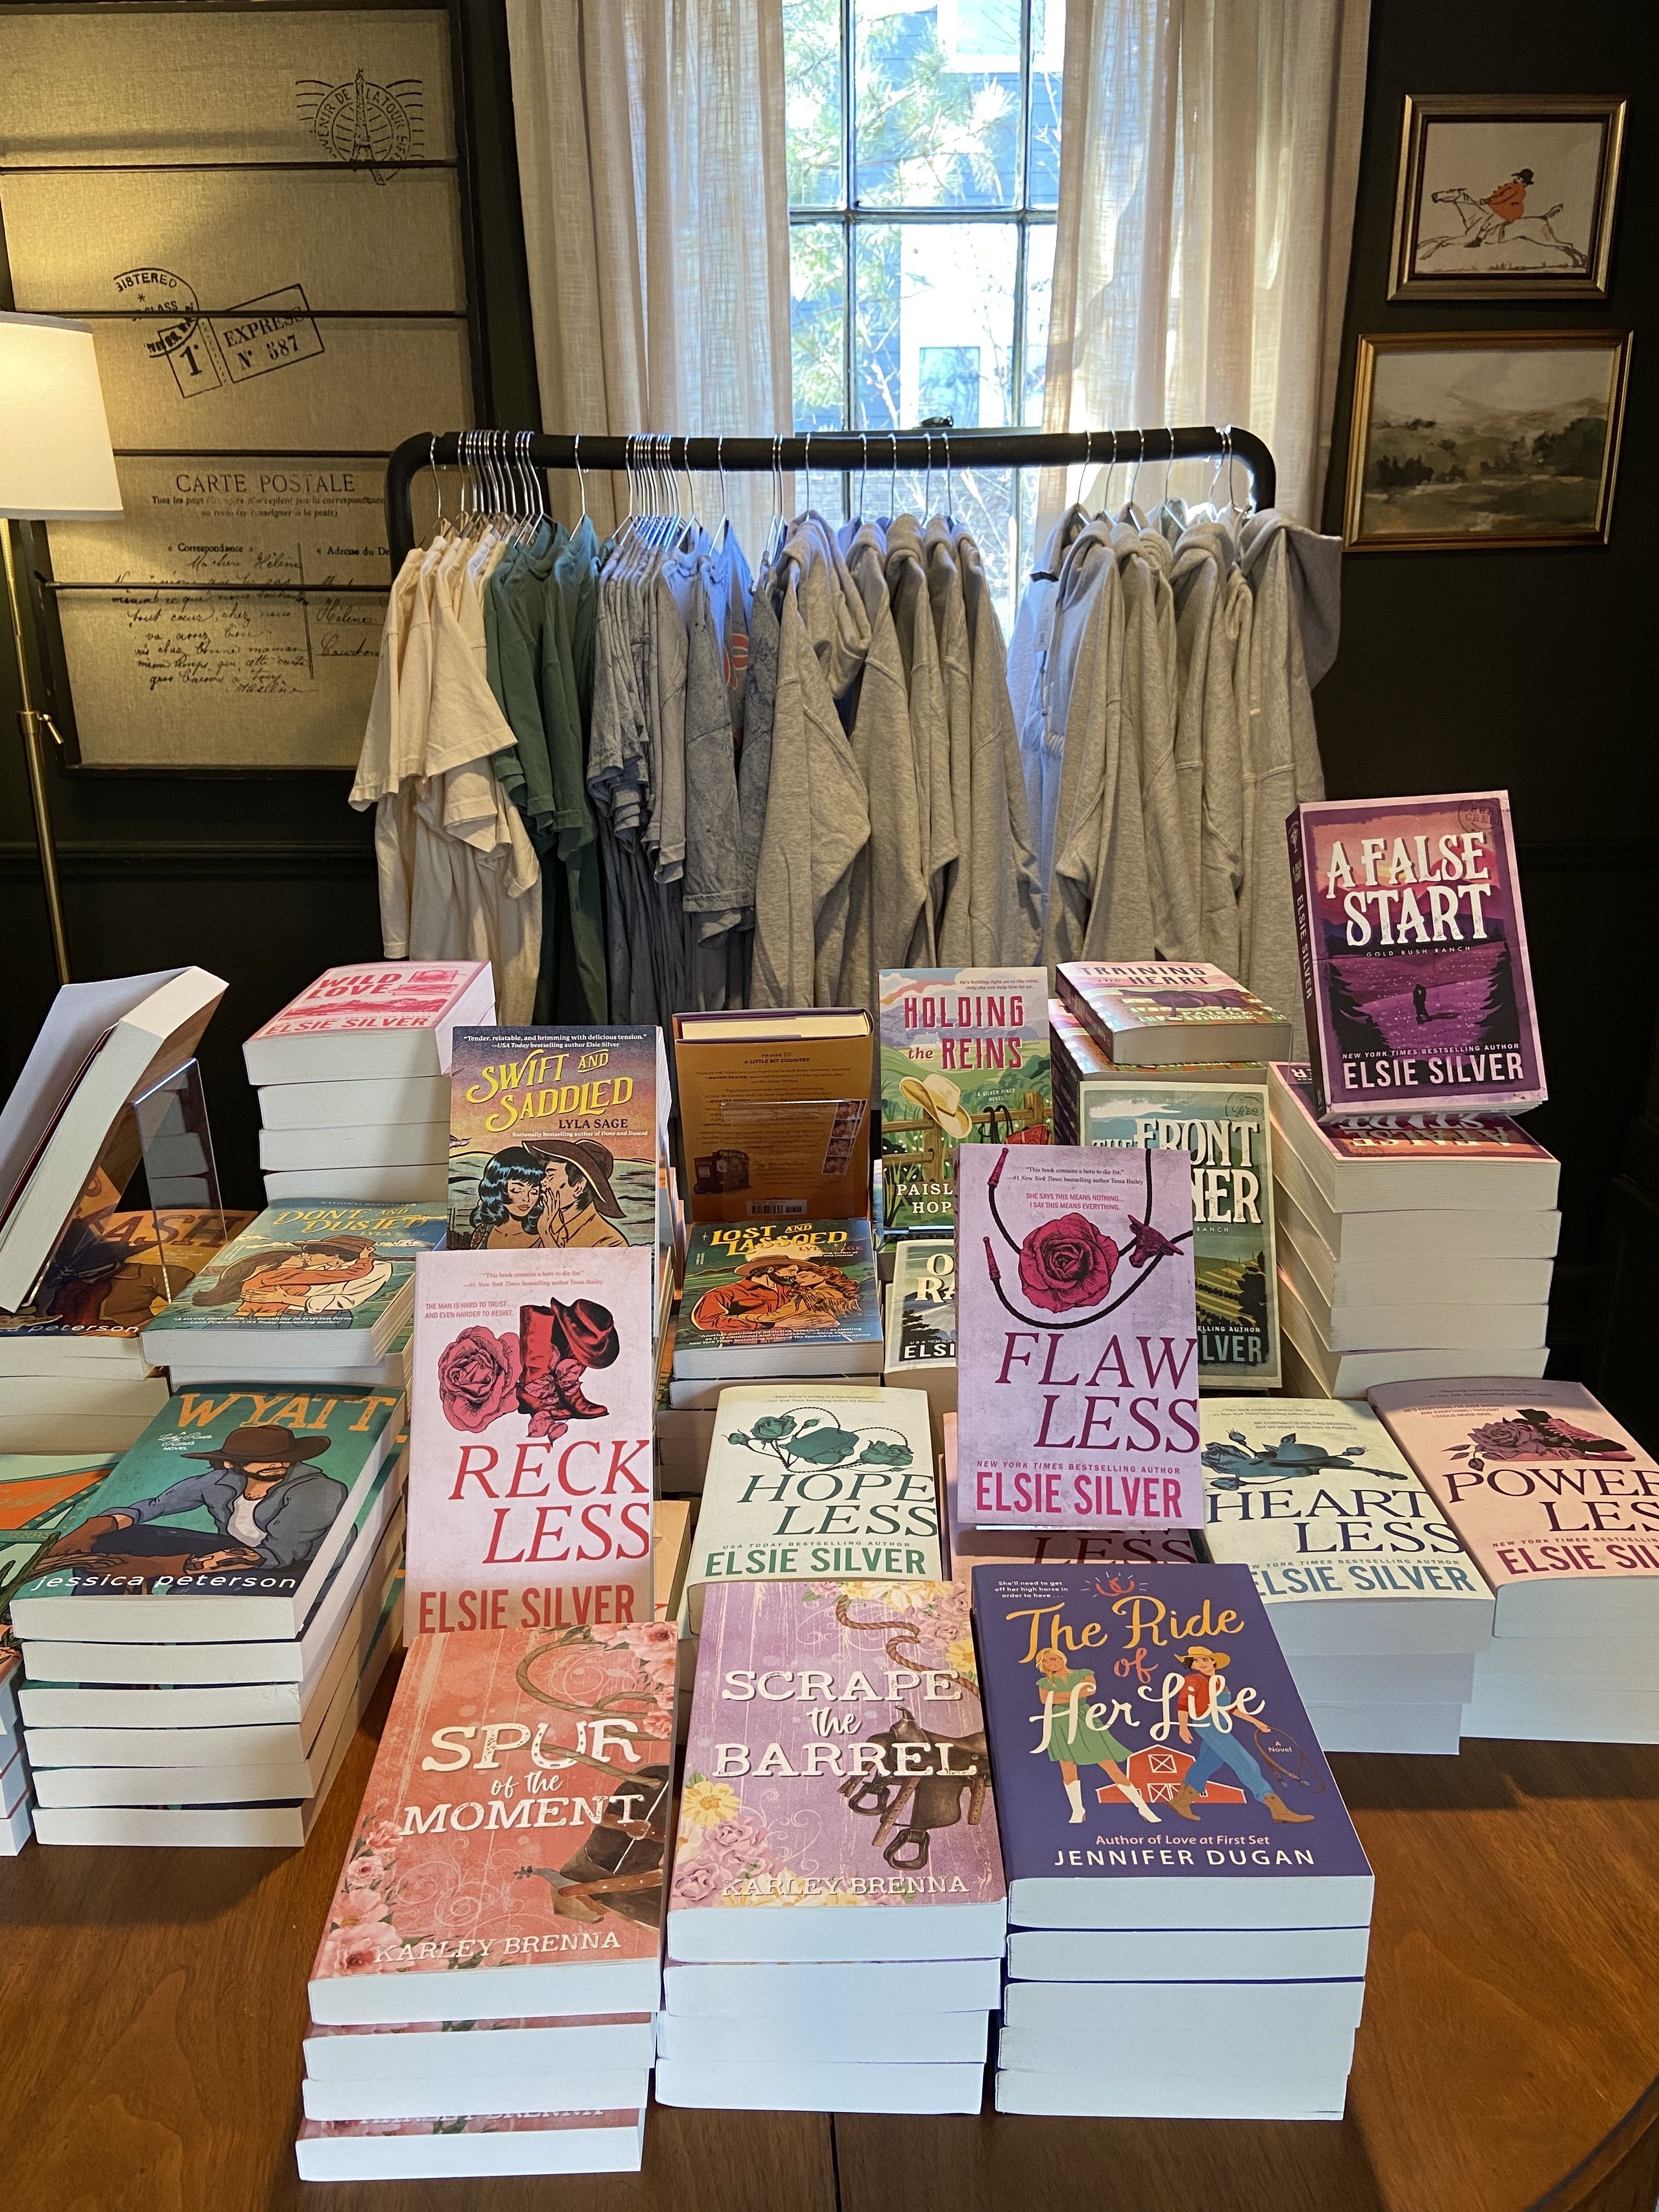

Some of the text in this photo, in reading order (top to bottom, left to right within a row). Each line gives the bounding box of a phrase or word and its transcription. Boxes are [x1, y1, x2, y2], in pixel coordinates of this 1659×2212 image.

[335, 89, 351, 104] DE
[223, 306, 304, 348] EXPRESS
[176, 473, 356, 493] CARTE POSTALE
[363, 546, 374, 555] du
[1327, 832, 1489, 899] A FALSE
[1343, 883, 1492, 946] START
[1366, 946, 1471, 958] GOLD RUSH RANCH
[319, 974, 403, 989] WILD
[1080, 967, 1207, 975] TRAINING
[1128, 976, 1209, 985] HEART
[306, 985, 390, 1000] LOVE
[266, 1018, 429, 1035] ELSIE SILVER
[903, 995, 1025, 1030] HOLDING
[908, 1036, 1023, 1070] the REINS
[1364, 1051, 1387, 1059] YORK
[1391, 1048, 1418, 1057] TIMES
[1421, 1045, 1481, 1055] BESTSELLING
[1483, 1043, 1520, 1051] AUTHOR
[466, 1048, 610, 1104] SWIFT AND
[1343, 1052, 1525, 1090] ELSIE SILVER
[485, 1076, 634, 1133] SADDLED
[558, 1119, 629, 1129] LYLA SAGE
[1133, 1118, 1259, 1167] FRONT
[710, 1223, 812, 1246] LOST AND
[726, 1232, 848, 1256] LASSOED
[27, 1323, 139, 1334] peterson
[995, 1331, 1197, 1390] FLAW
[178, 1393, 397, 1431] WYATT
[1034, 1394, 1200, 1453] LESS
[448, 1440, 650, 1500] RECK
[1069, 1464, 1136, 1473] BESTSELLING
[1141, 1466, 1181, 1475] AUTHOR
[737, 1473, 935, 1503] HOPE
[977, 1471, 1182, 1518] ELSIE SILVER
[772, 1504, 938, 1537] LESS
[1206, 1489, 1426, 1523] HEART
[482, 1502, 650, 1564] LESS
[1295, 1521, 1466, 1554] LESS
[705, 1547, 927, 1577] ELSIE SILVER
[1496, 1545, 1606, 1575] ELSIE
[31, 1573, 297, 1593] jessica peterson
[1348, 1565, 1477, 1592] SILVER
[419, 1584, 635, 1634] ELSIE SILVER
[1005, 1595, 1244, 1663] The Ride
[1114, 1647, 1159, 1684] of
[721, 1669, 963, 1701] SCRAPE
[806, 1706, 862, 1738] the
[1029, 1672, 1266, 1754] Her Life
[421, 1718, 642, 1772] SPUR
[712, 1742, 978, 1778] BARREL
[490, 1770, 564, 1799] of the
[398, 1794, 646, 1836] MOMENT
[1096, 1835, 1269, 1846] Author of Love at First Set
[1054, 1849, 1316, 1866] JENNIFER DUGAN
[722, 1876, 970, 1897] KARLEY BRENNA
[373, 1931, 622, 1963] KARLEY BRENNA
